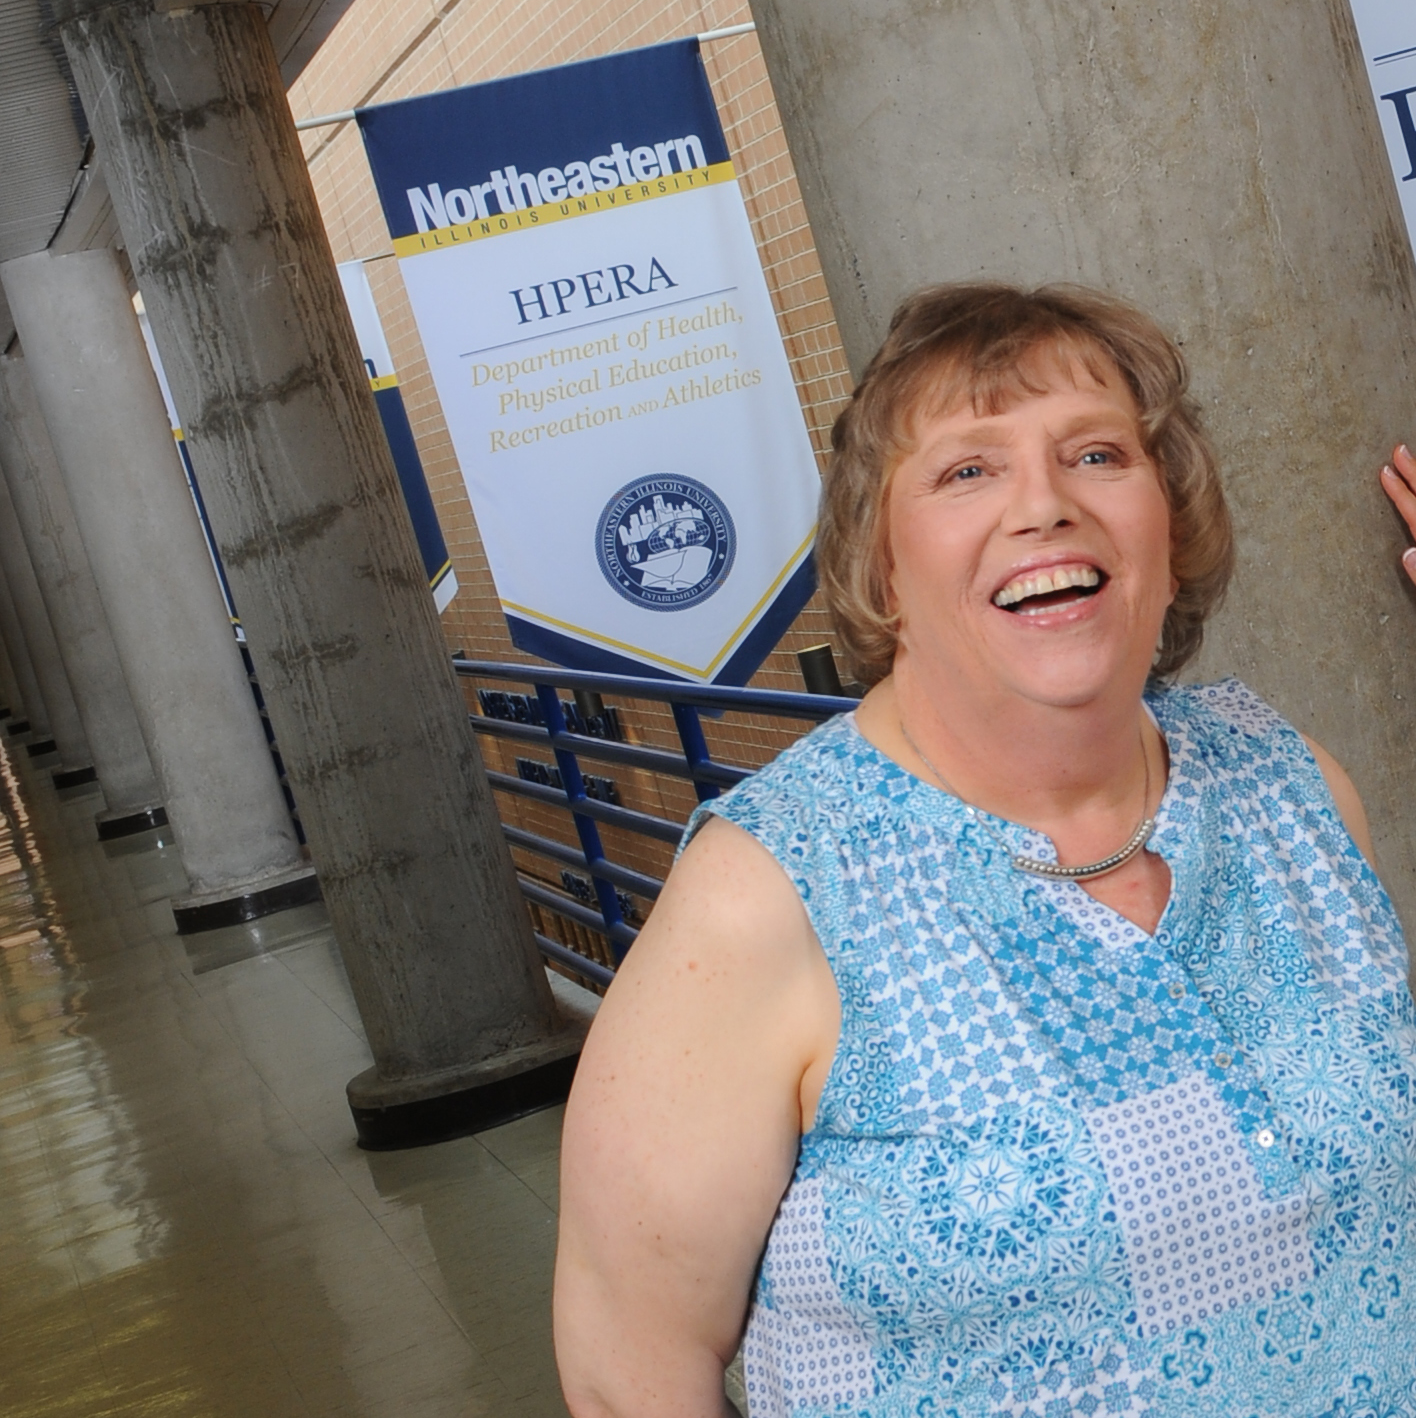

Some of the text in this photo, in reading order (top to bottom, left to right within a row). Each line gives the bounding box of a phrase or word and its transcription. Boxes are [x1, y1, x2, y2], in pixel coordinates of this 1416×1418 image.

[406, 134, 708, 234] Northeastern
[420, 170, 712, 249] ILLINOIS UNIVERSITY
[508, 255, 679, 325] HPERA
[471, 301, 744, 388] Department of Health,
[498, 342, 738, 416] Physical Education,
[488, 367, 762, 454] Recreation AND Athletics
[604, 481, 727, 579] NORTHEASTERN ILLINOIS UNIVERSITY
